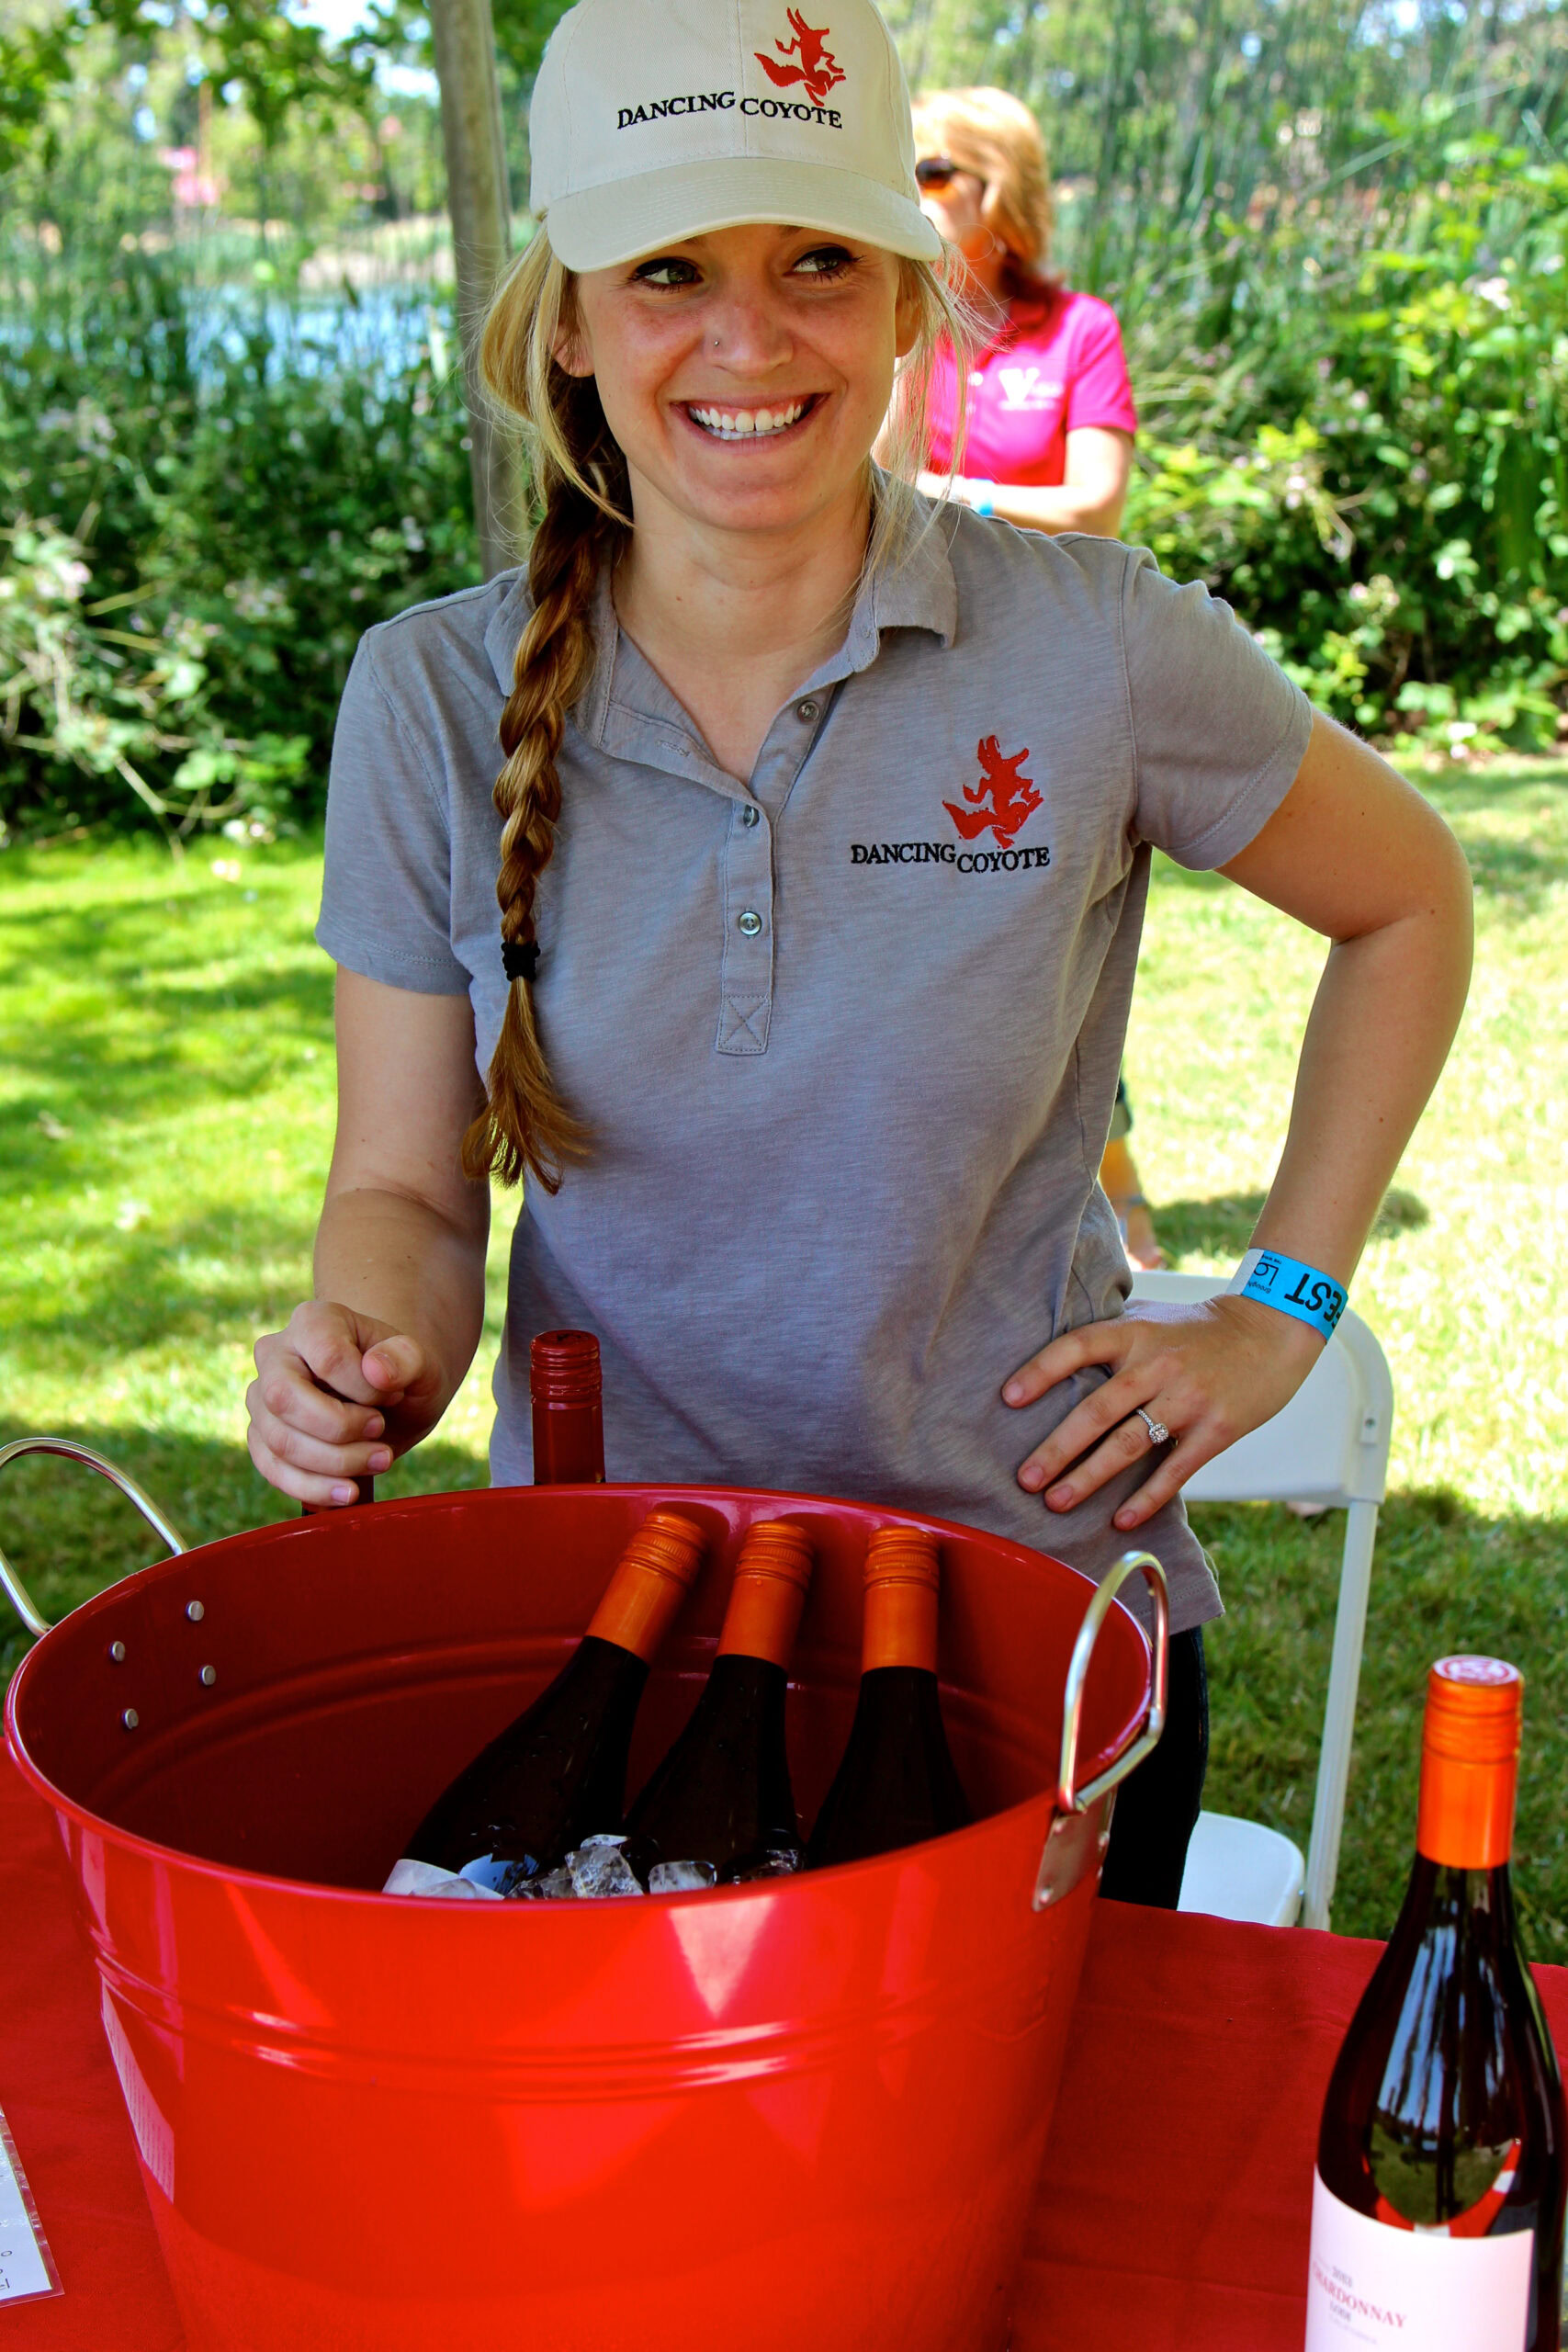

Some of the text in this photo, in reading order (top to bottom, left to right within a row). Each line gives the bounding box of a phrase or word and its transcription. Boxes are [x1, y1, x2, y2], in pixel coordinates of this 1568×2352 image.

[616, 91, 843, 130] DANCING COYOTE
[851, 842, 1051, 874] DANCING COYOTE
